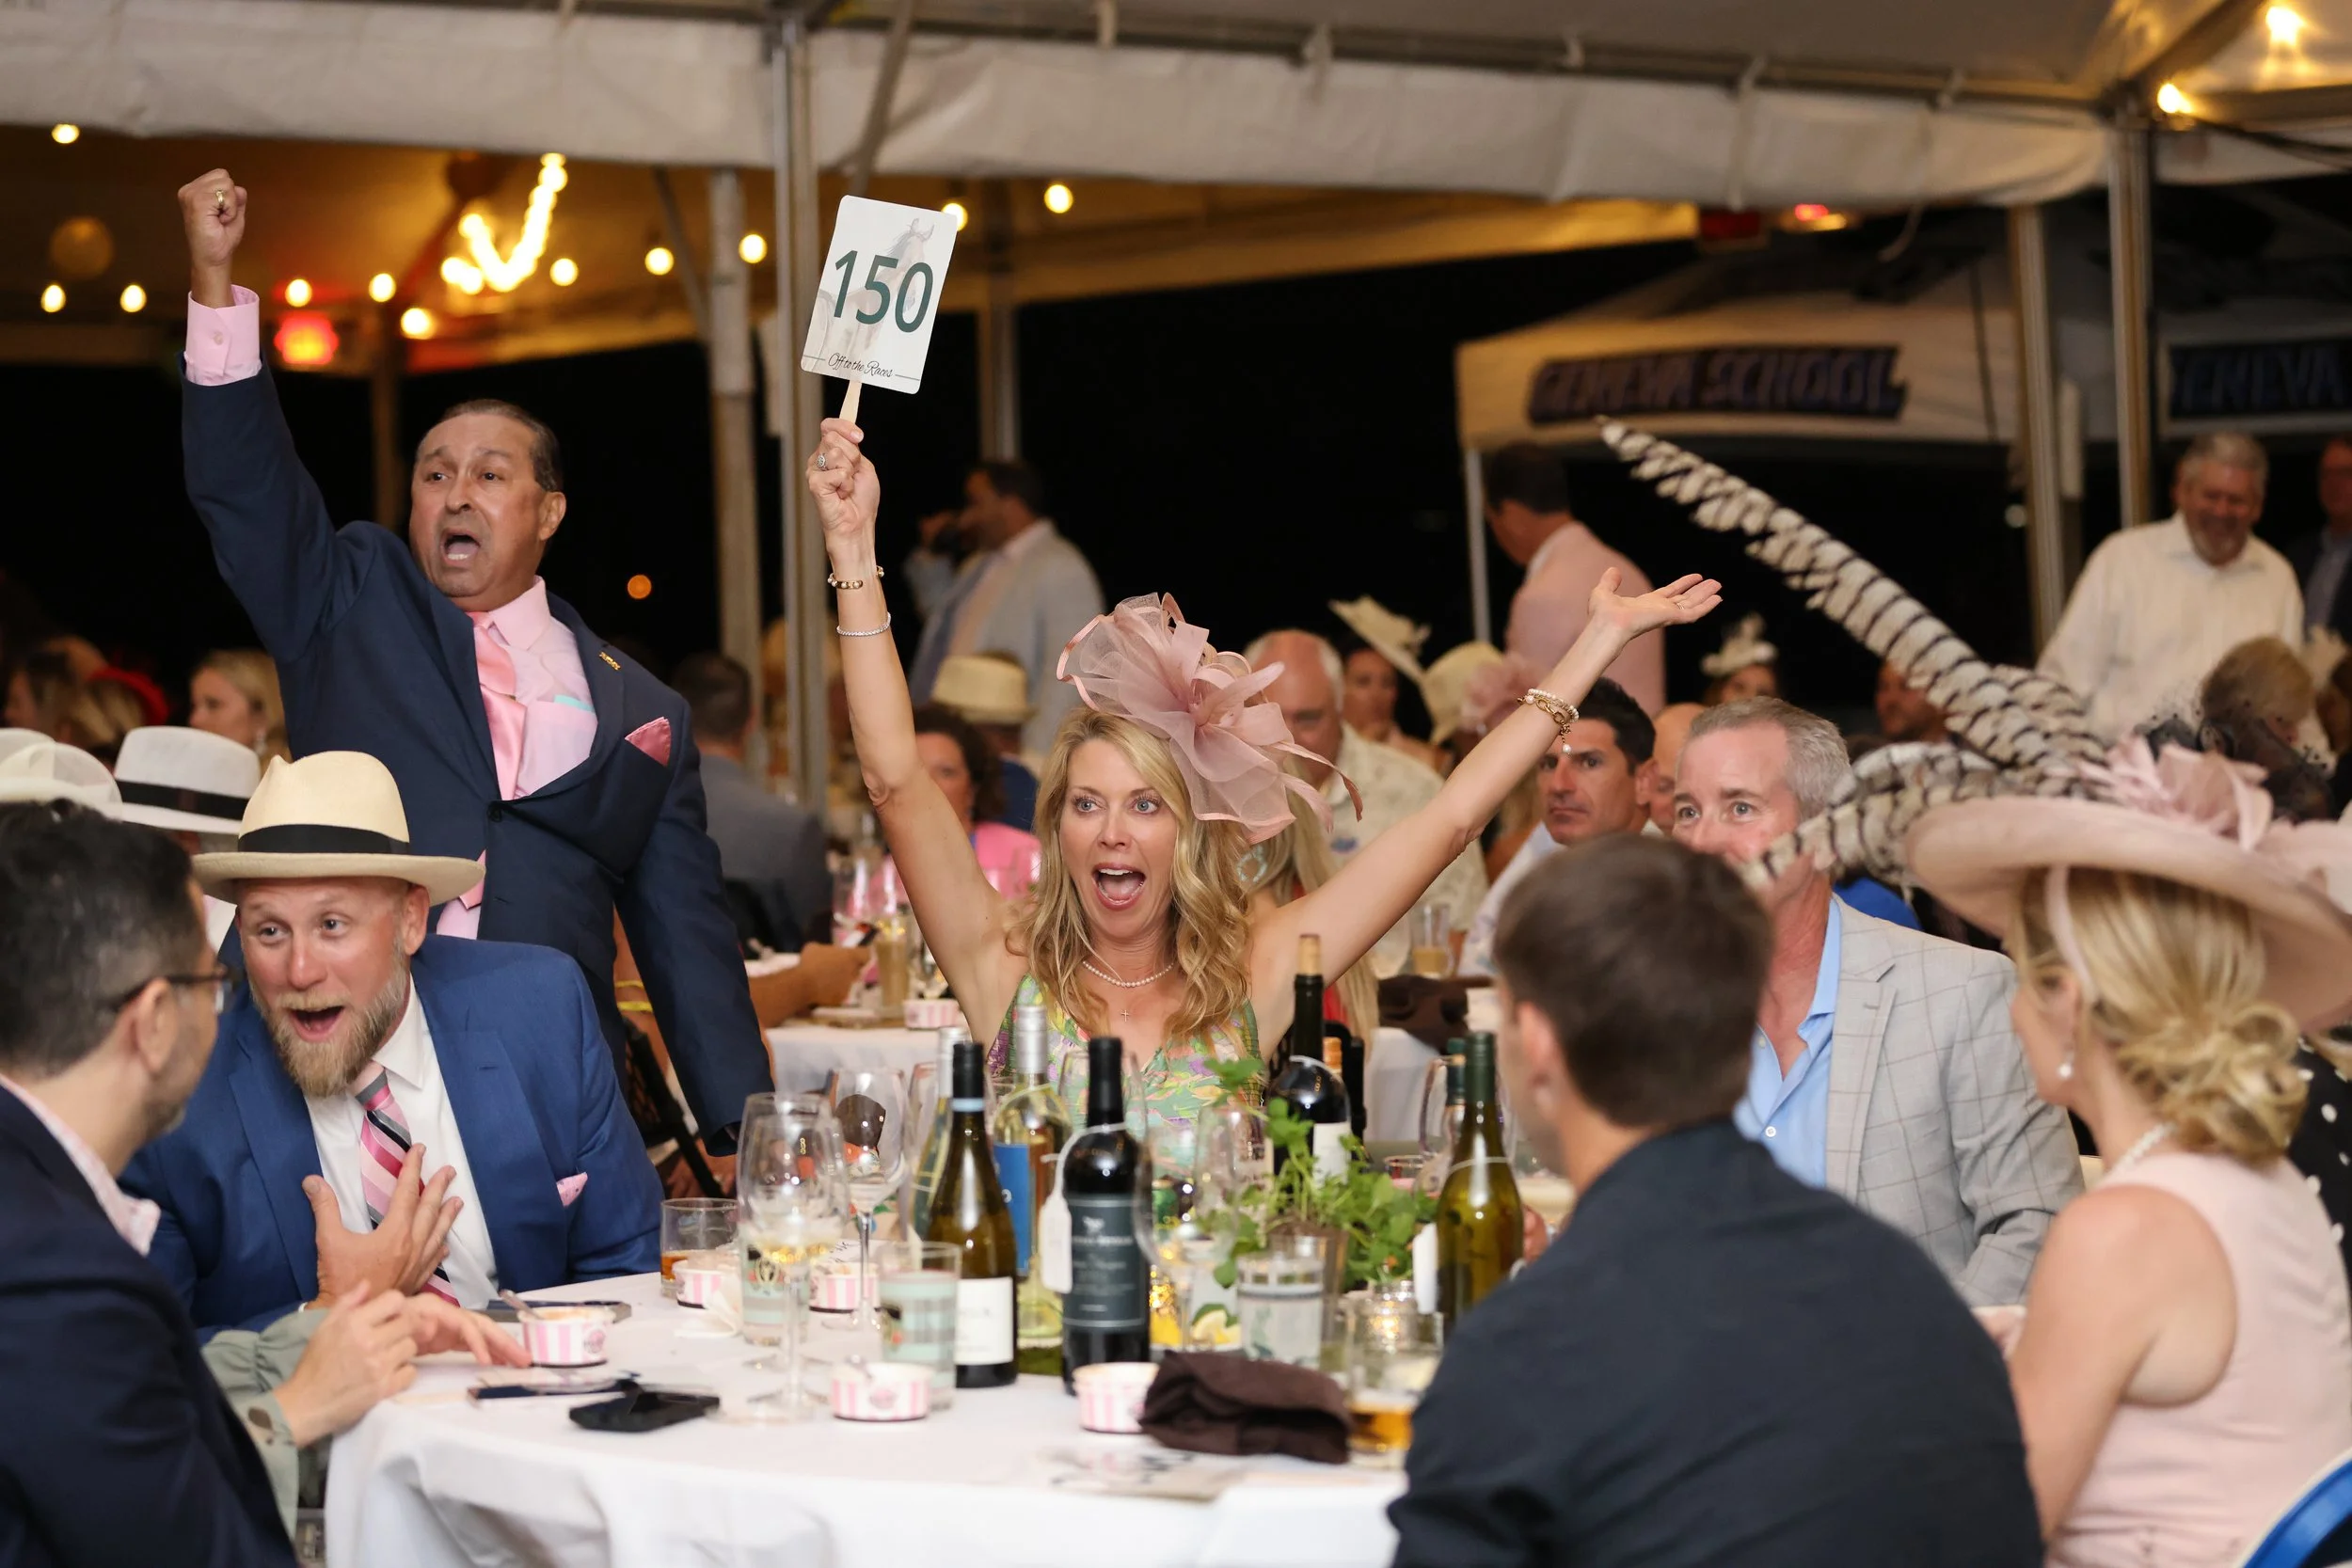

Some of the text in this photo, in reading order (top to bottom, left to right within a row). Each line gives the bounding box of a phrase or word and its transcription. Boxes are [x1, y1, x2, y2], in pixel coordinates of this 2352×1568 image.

[834, 250, 933, 333] 150
[828, 353, 893, 377] Off to the Races
[1701, 348, 1902, 417] SCHOOL
